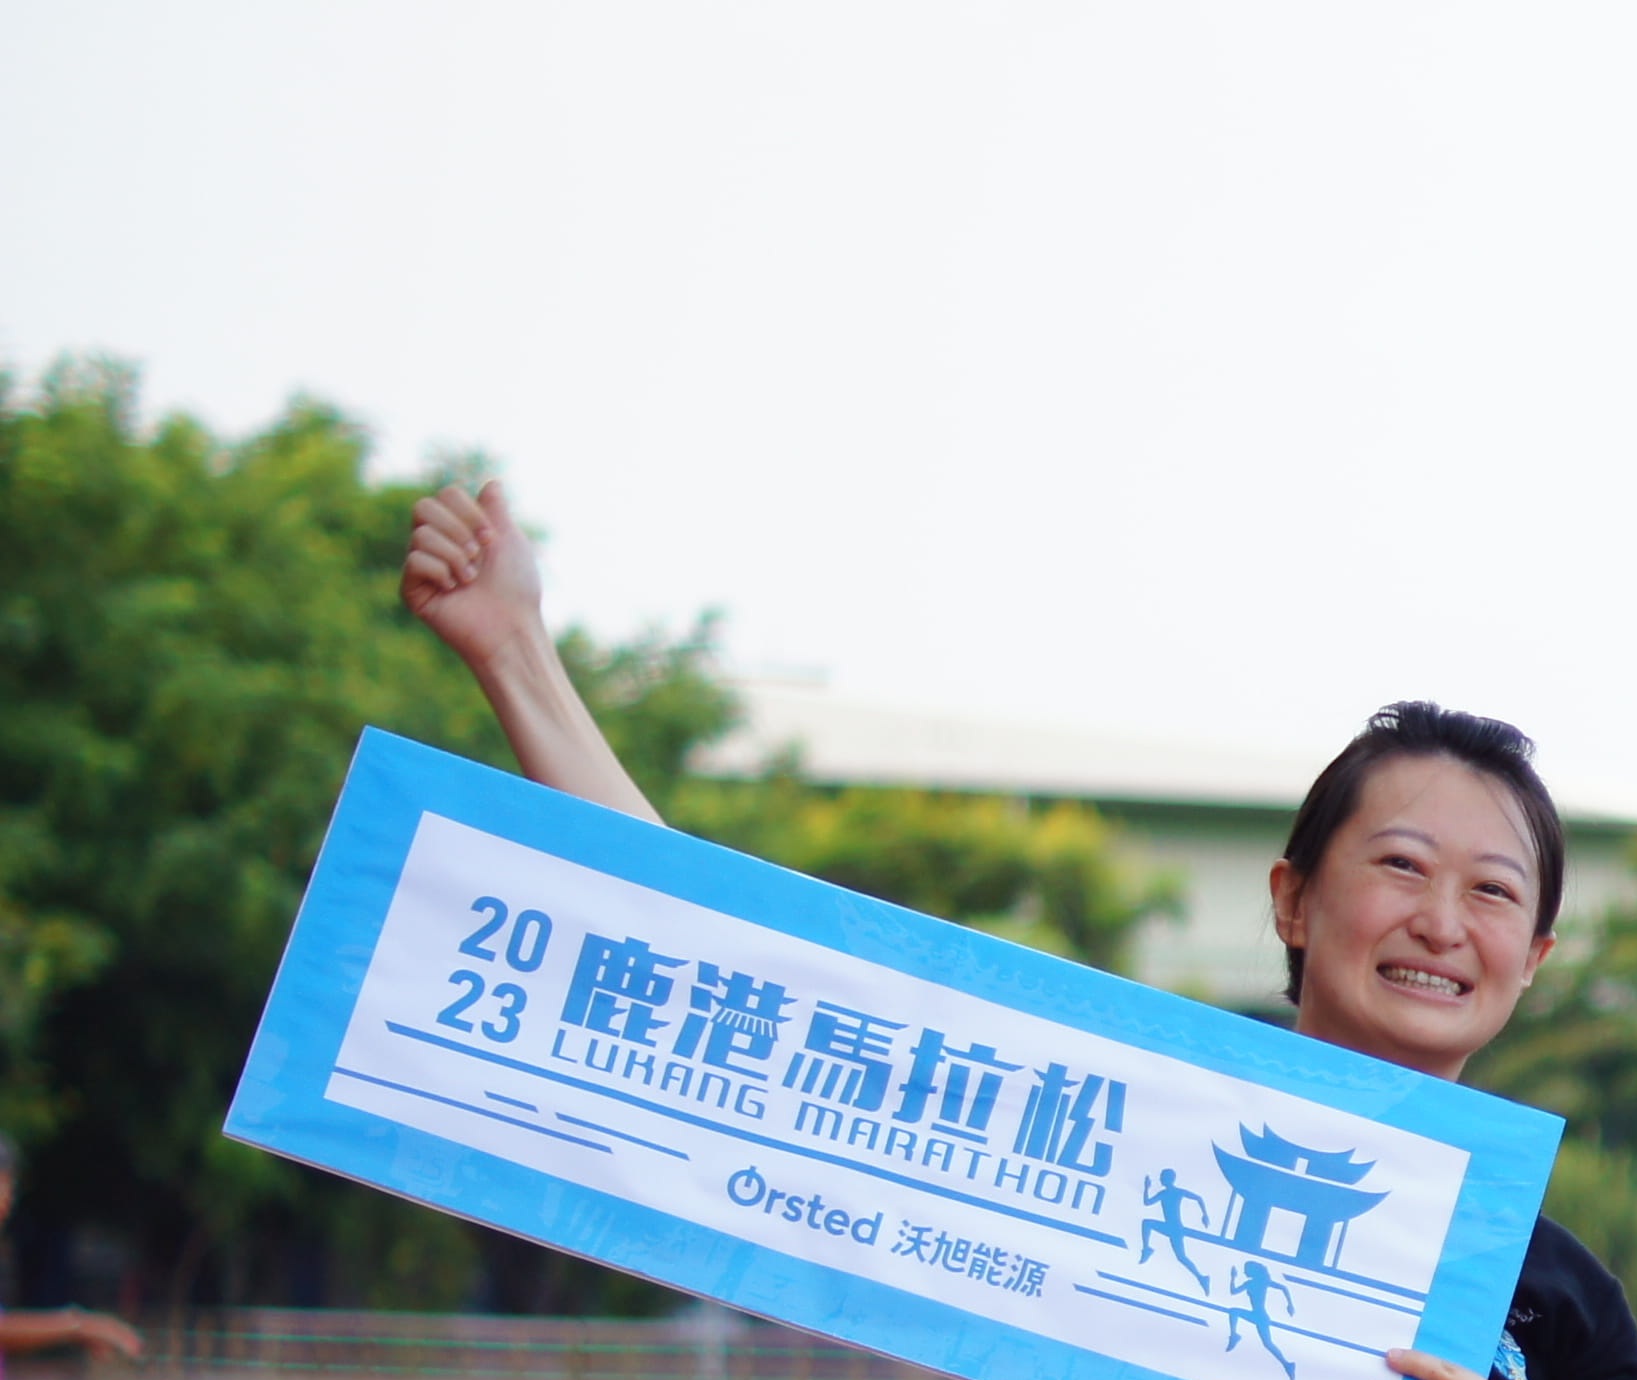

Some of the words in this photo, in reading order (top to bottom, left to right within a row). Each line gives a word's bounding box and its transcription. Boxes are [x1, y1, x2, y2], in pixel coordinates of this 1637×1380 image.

[458, 896, 553, 973] 20
[436, 968, 527, 1043] 23
[560, 932, 1127, 1177] 鹿港馬拉松
[551, 1029, 769, 1120] LUKANG
[794, 1100, 1106, 1215] MARATHON
[890, 1218, 1050, 1298] 沃旭能源
